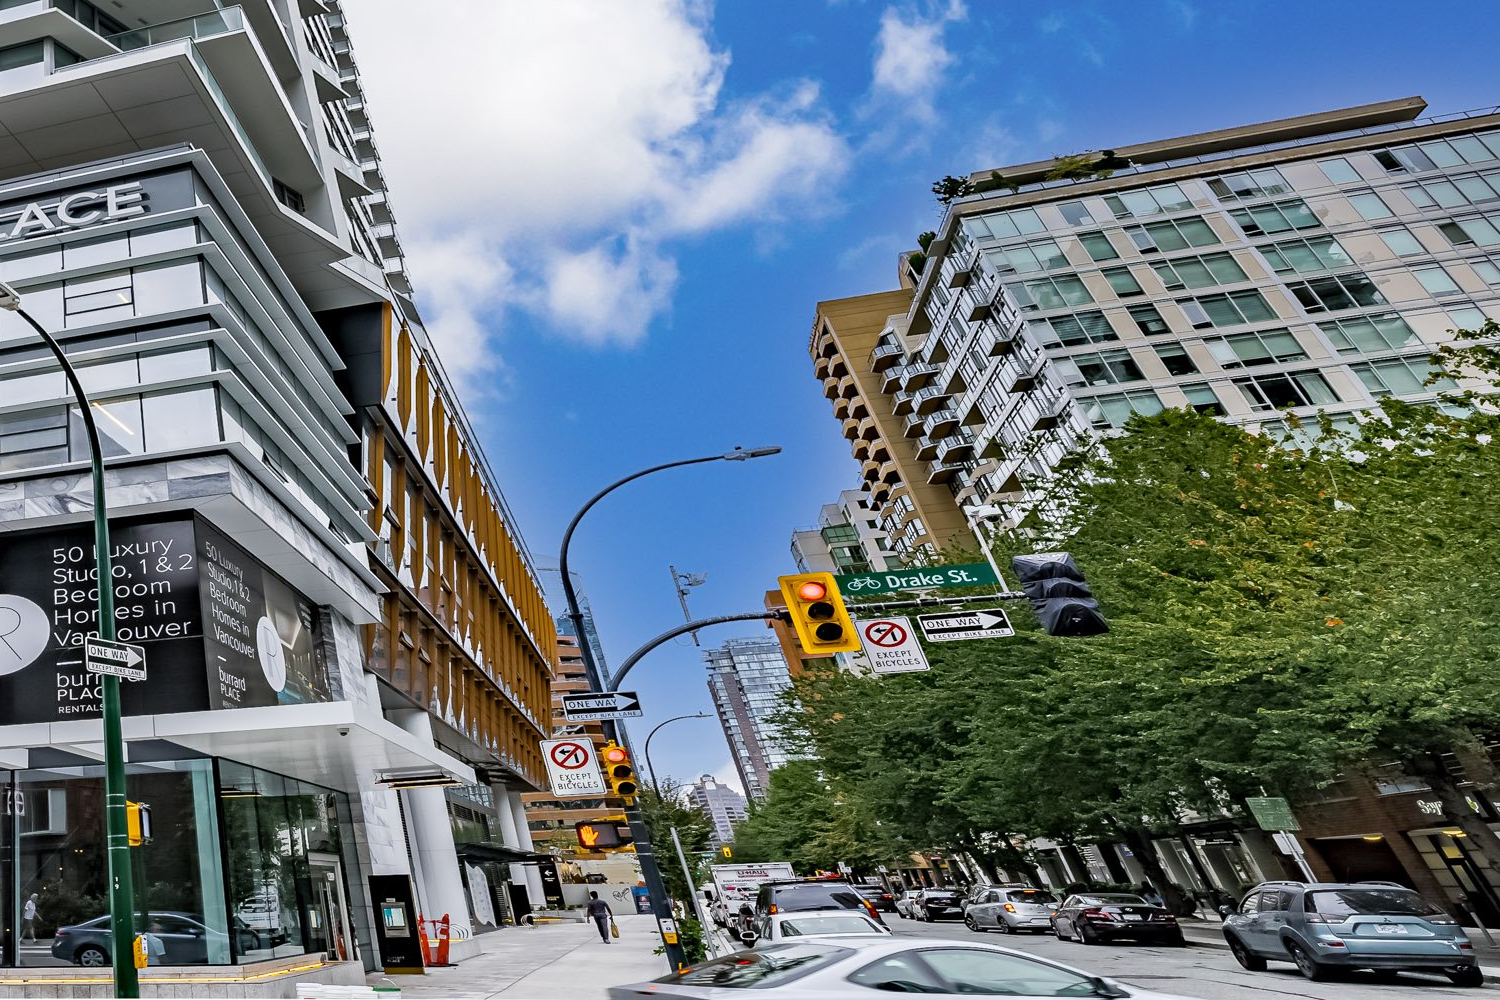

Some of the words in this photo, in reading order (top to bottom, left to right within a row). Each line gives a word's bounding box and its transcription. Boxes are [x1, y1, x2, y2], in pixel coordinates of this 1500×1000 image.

[53, 546, 84, 565] 50
[139, 559, 147, 574] 1
[155, 556, 174, 573] &
[178, 553, 194, 571] 2
[205, 541, 218, 562] 50
[218, 551, 244, 582] Luxury
[207, 561, 234, 591] Studio,
[245, 586, 251, 602] 2
[885, 572, 945, 589] Drake
[949, 570, 978, 583] St.
[209, 581, 247, 617] Bedroom
[155, 600, 176, 616] in
[211, 602, 242, 632] Homes
[241, 624, 250, 638] in
[926, 619, 952, 629] ONE
[956, 617, 982, 627] WAY
[213, 622, 255, 660] Vancouver
[933, 631, 962, 639] EXCEPT
[964, 630, 982, 638] BIKE
[90, 646, 108, 658] ONE
[111, 650, 130, 661] WAY
[876, 650, 911, 659] EXCEPT
[91, 663, 112, 672] EXCEPT
[113, 666, 126, 675] BIKE
[127, 669, 142, 677] LANE
[876, 658, 921, 668] BICYCLES
[218, 665, 247, 692] burrard
[220, 682, 242, 703] PLACE
[568, 700, 591, 709] ONE
[595, 698, 617, 707] WAY
[558, 781, 598, 790] BICYCLES
[559, 773, 591, 781] EXCEPT
